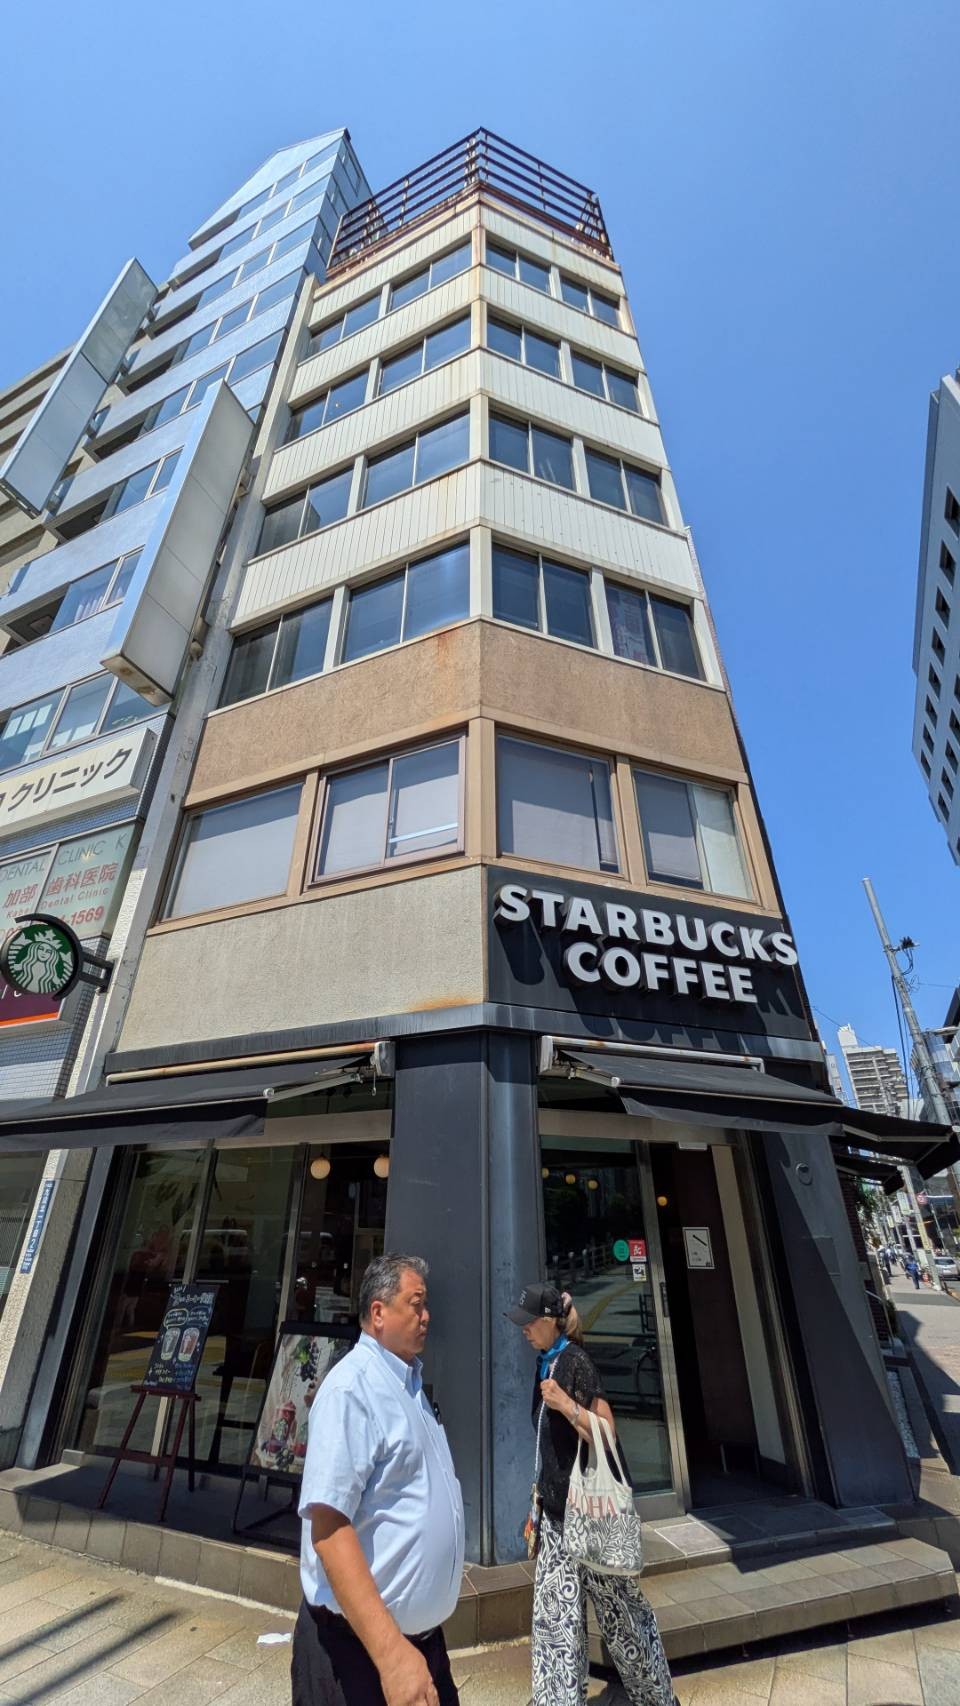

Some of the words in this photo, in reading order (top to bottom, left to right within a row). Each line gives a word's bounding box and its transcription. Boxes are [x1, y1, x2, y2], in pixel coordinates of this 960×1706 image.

[0, 748, 133, 812] クリニック
[1, 861, 44, 881] DENTAL
[58, 840, 106, 865] CLINIC
[115, 833, 127, 850] K
[46, 862, 119, 896] 歯科医院
[77, 887, 110, 900] Clinic
[494, 883, 798, 967] STARBUCKS
[564, 941, 758, 1004] COFFEE
